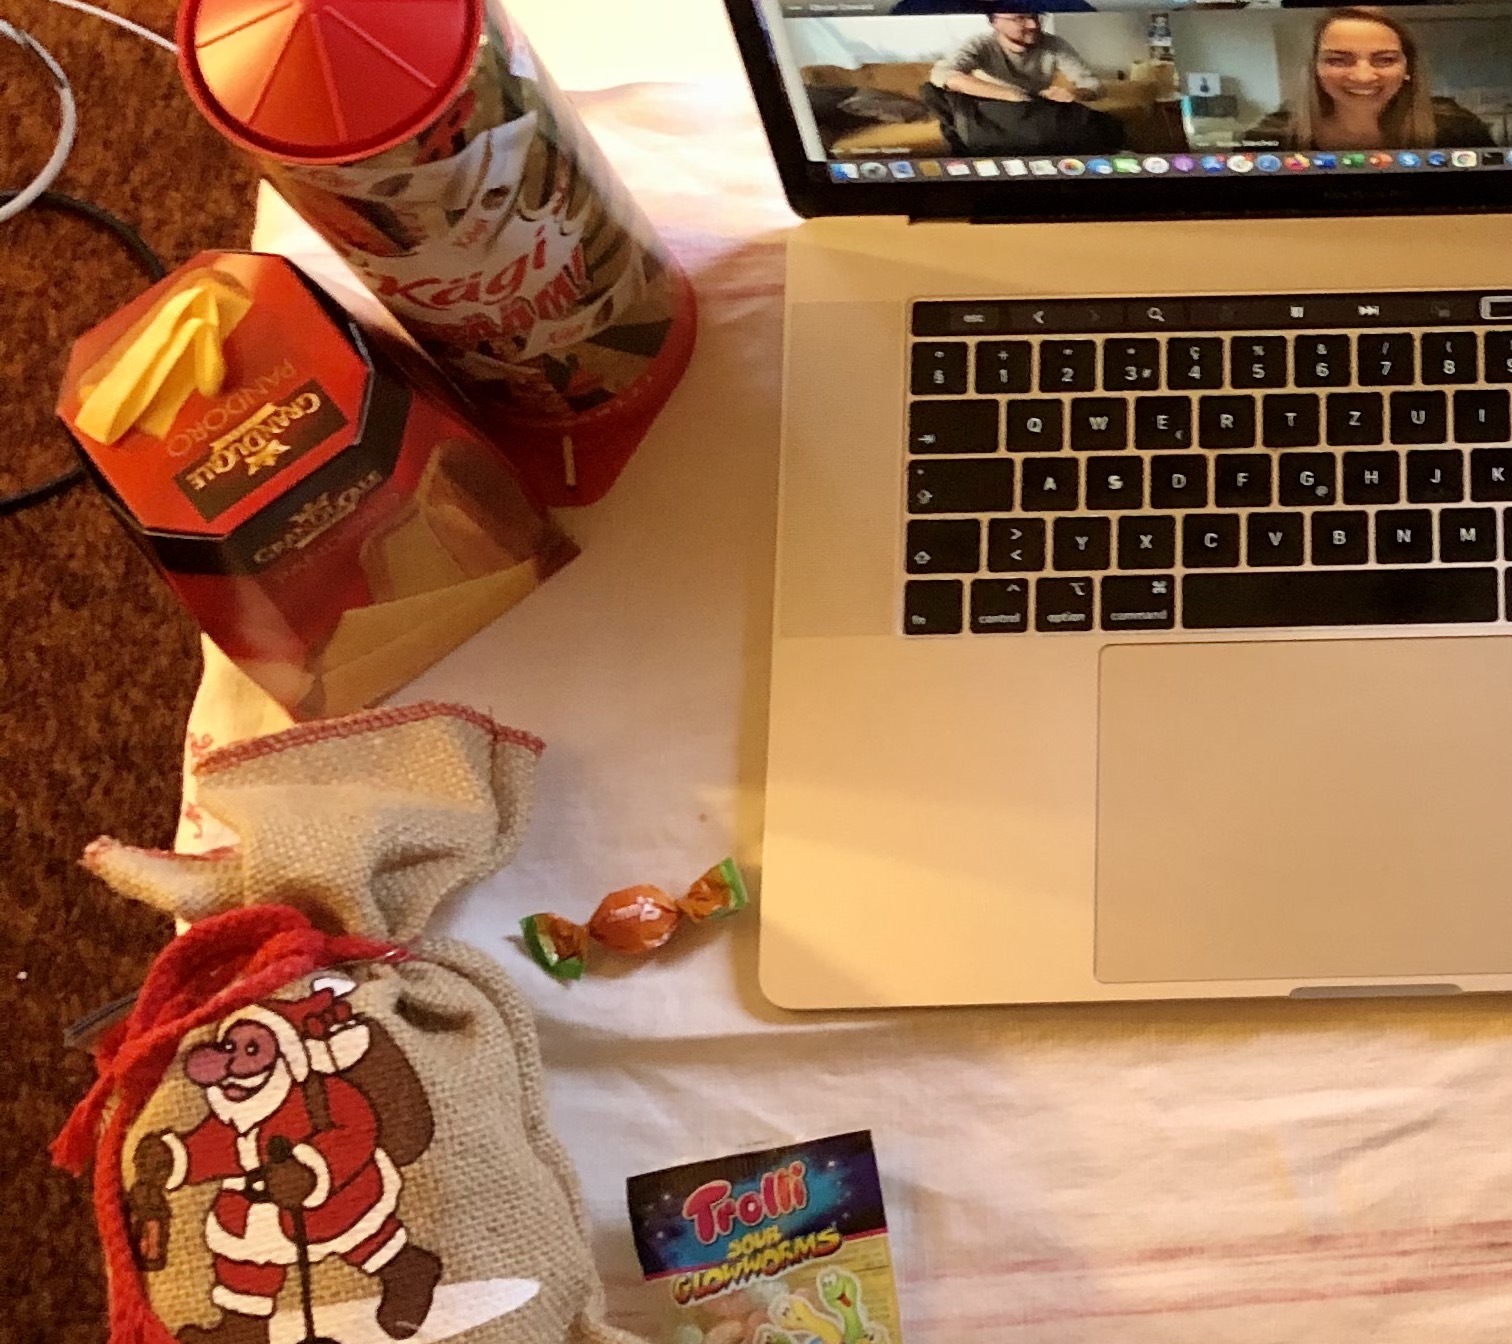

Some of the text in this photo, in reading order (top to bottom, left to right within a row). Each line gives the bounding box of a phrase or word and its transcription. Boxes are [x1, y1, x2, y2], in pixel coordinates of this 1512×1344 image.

[1061, 367, 1074, 382] 2
[1125, 366, 1138, 381] 3
[1252, 363, 1266, 379] 5
[1315, 362, 1330, 377] 6
[1380, 361, 1392, 376] 7
[1443, 359, 1456, 375] 8
[1026, 417, 1042, 433] Q
[1088, 416, 1109, 431] W
[1156, 414, 1168, 430] E
[1220, 413, 1234, 428] R
[1285, 412, 1297, 427] T
[1348, 411, 1362, 426] Z
[1410, 410, 1426, 425] U
[1478, 408, 1486, 423] I
[1043, 476, 1057, 491] A
[1107, 475, 1123, 490] S
[1171, 473, 1187, 489] D
[1237, 472, 1248, 487] F
[1299, 471, 1315, 486] G
[1364, 469, 1379, 484] H
[1430, 468, 1441, 484] J
[1491, 467, 1505, 482] K
[1074, 536, 1089, 551] Y
[1139, 534, 1153, 549] X
[1204, 532, 1218, 548] C
[1268, 531, 1283, 546] V
[1332, 530, 1347, 545] B
[1396, 529, 1412, 543] N
[1459, 527, 1476, 542] M
[683, 1160, 808, 1244] Trolli
